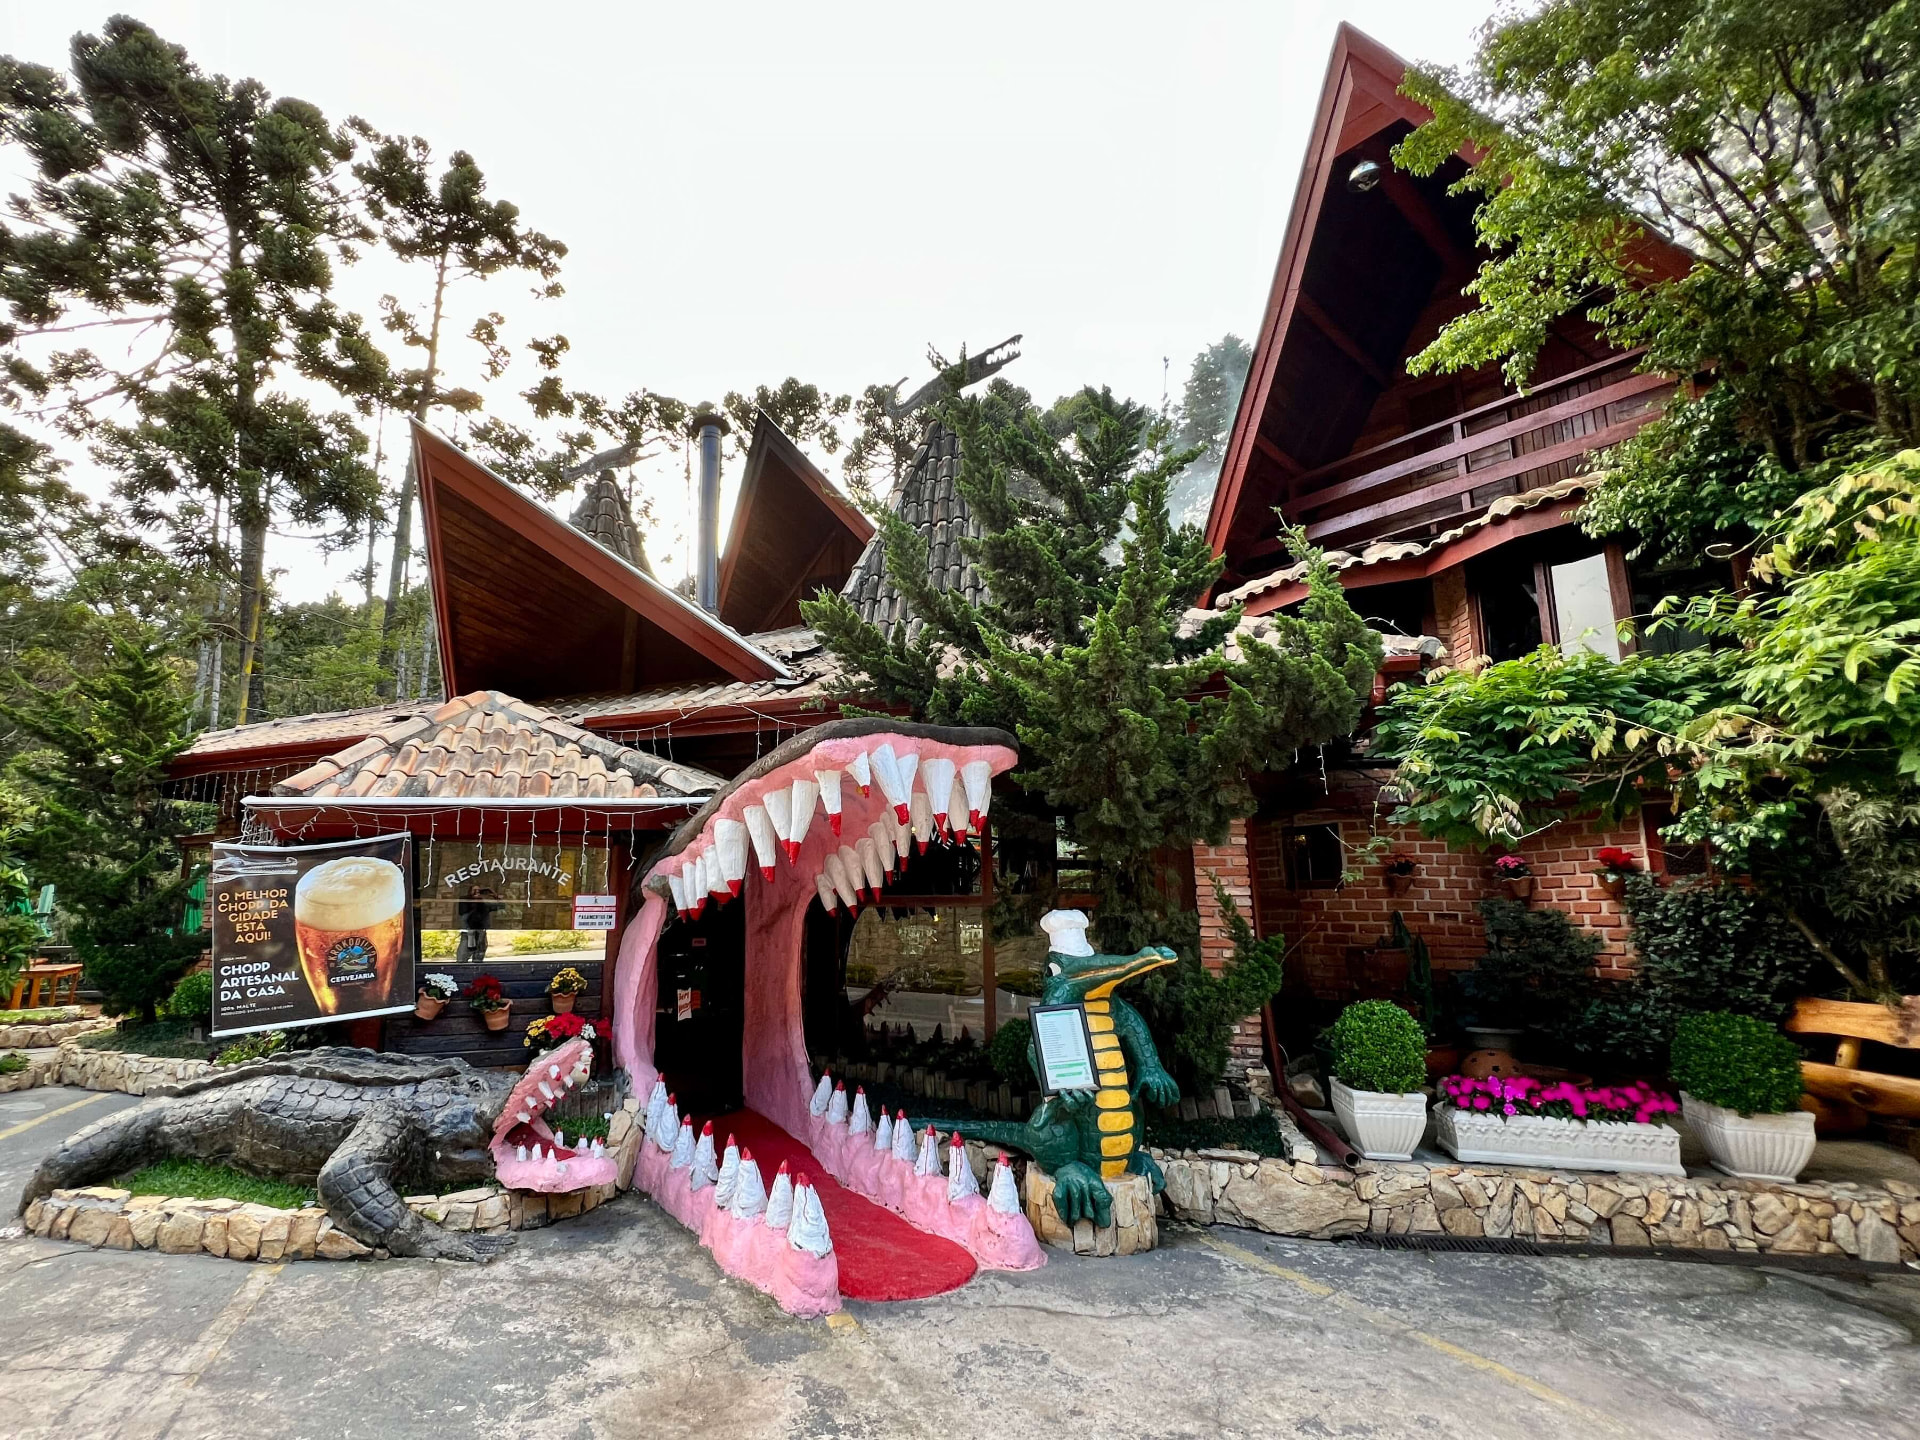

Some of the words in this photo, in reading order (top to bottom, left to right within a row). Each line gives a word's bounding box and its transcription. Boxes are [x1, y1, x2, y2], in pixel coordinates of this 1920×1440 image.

[444, 857, 572, 888] RESTAURANTE
[219, 892, 230, 902] O
[234, 888, 288, 901] MELHOR
[217, 900, 266, 913] CHOPP
[269, 899, 289, 909] DA
[228, 909, 279, 922] CIDADE
[235, 919, 266, 933] ESTÁ
[234, 931, 271, 944] AQUI!
[220, 961, 271, 976] CHOPP
[220, 970, 299, 989] ARTESANAL
[330, 972, 375, 984] CERVEJARIA
[220, 989, 242, 1002] DA
[246, 985, 285, 998] CASA
